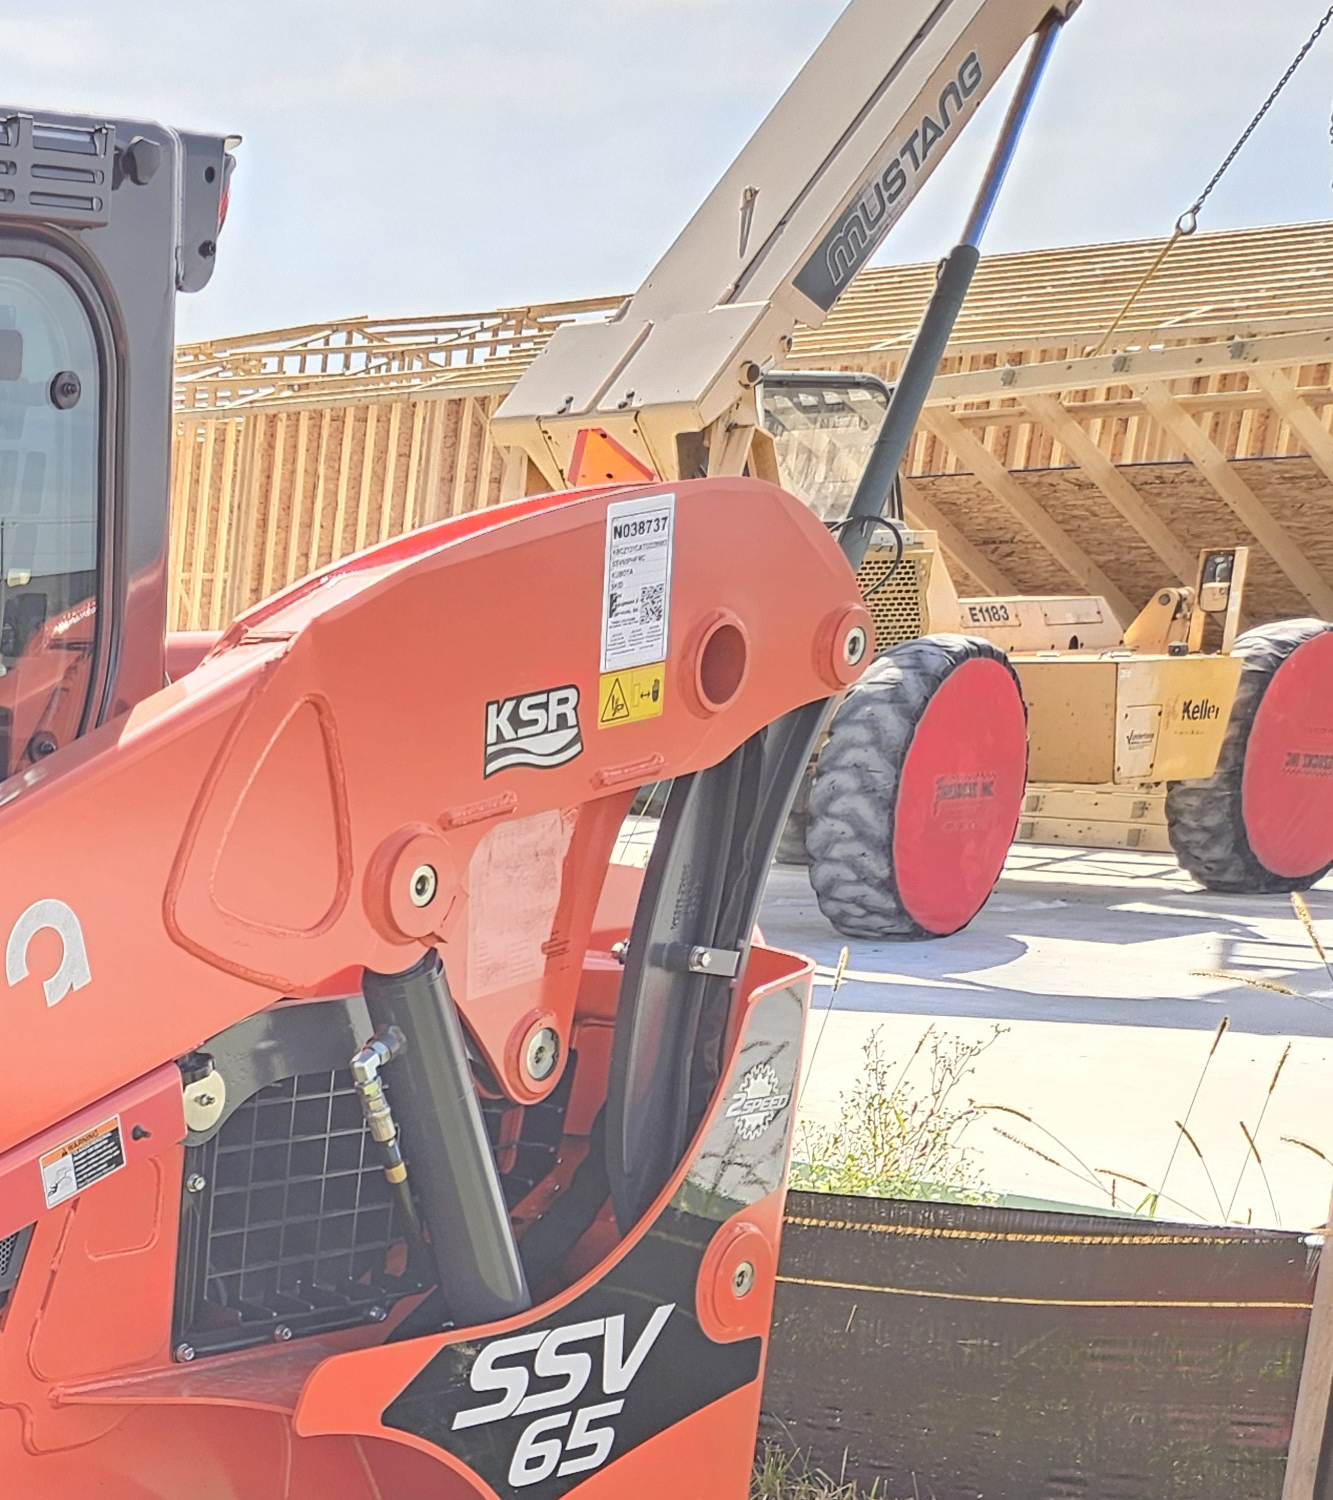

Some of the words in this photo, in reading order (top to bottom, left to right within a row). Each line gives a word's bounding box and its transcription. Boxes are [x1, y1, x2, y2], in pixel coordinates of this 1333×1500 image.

[826, 51, 983, 286] MUSTANG
[613, 516, 669, 540] N038737
[968, 604, 1010, 623] E1183
[486, 685, 580, 746] KSR
[451, 1302, 677, 1432] SSV
[508, 1398, 624, 1488] 65
